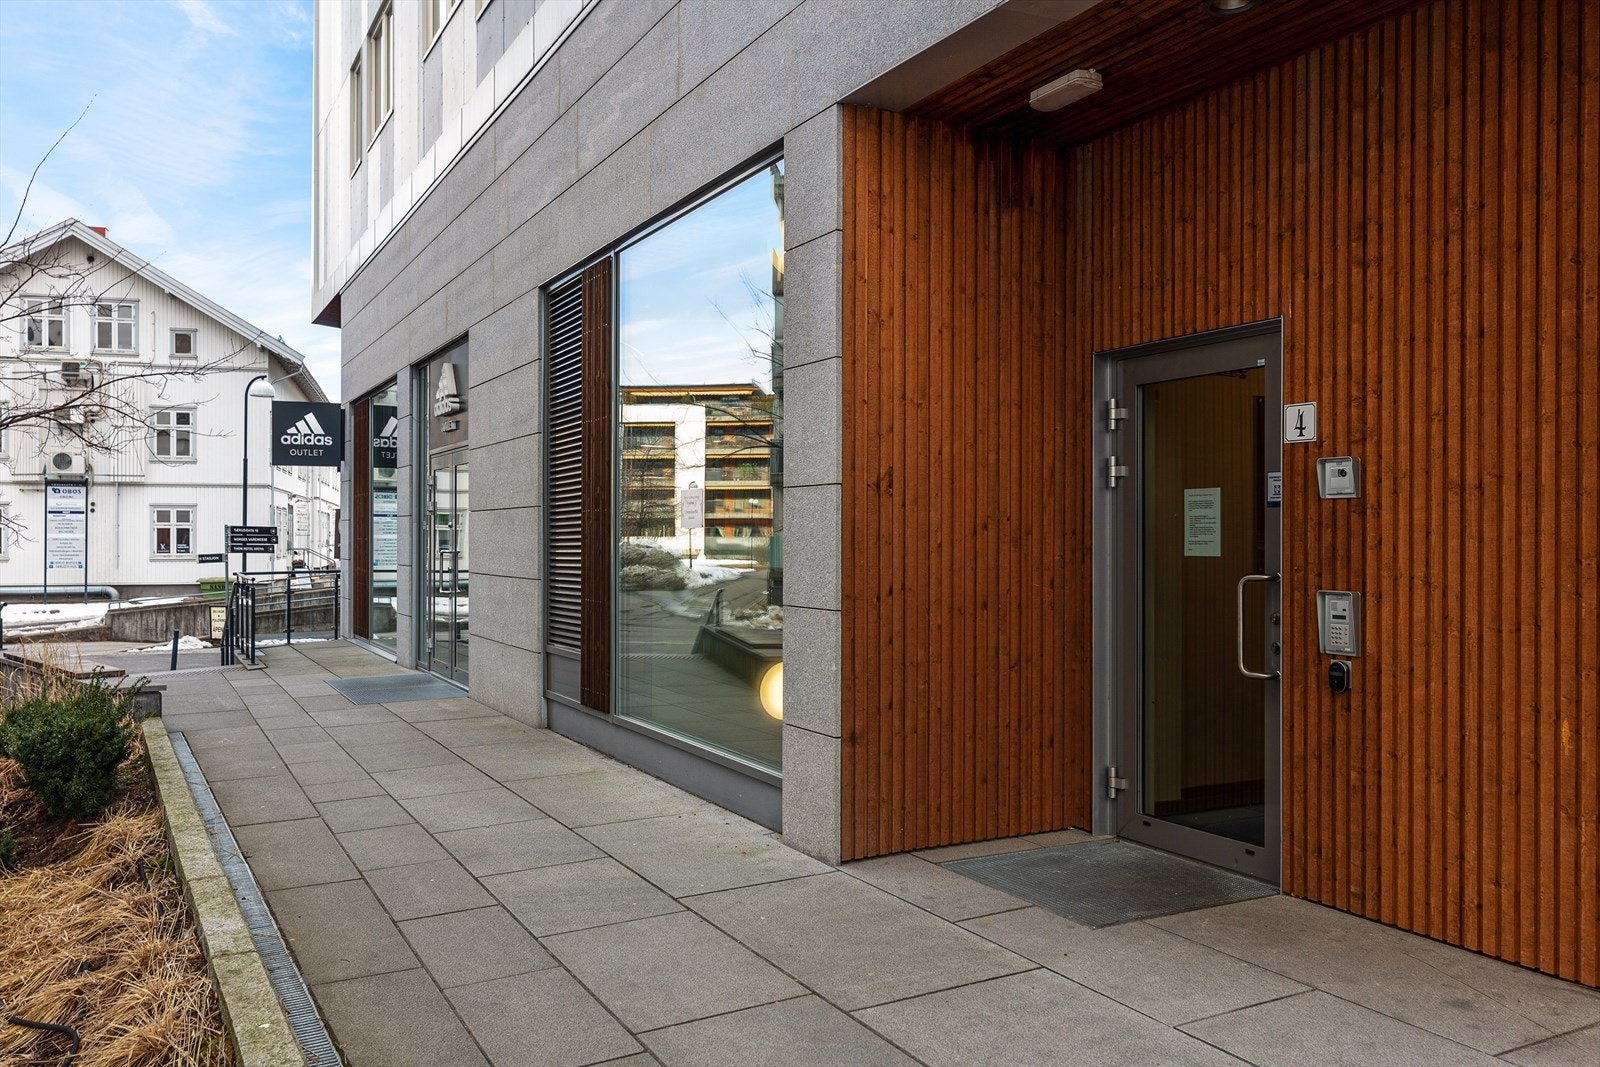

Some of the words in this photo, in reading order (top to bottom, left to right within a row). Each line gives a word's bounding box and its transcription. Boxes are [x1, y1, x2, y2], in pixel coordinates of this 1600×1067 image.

[1294, 408, 1307, 437] 4
[280, 433, 333, 446] adidas
[289, 448, 324, 457] OUTLET
